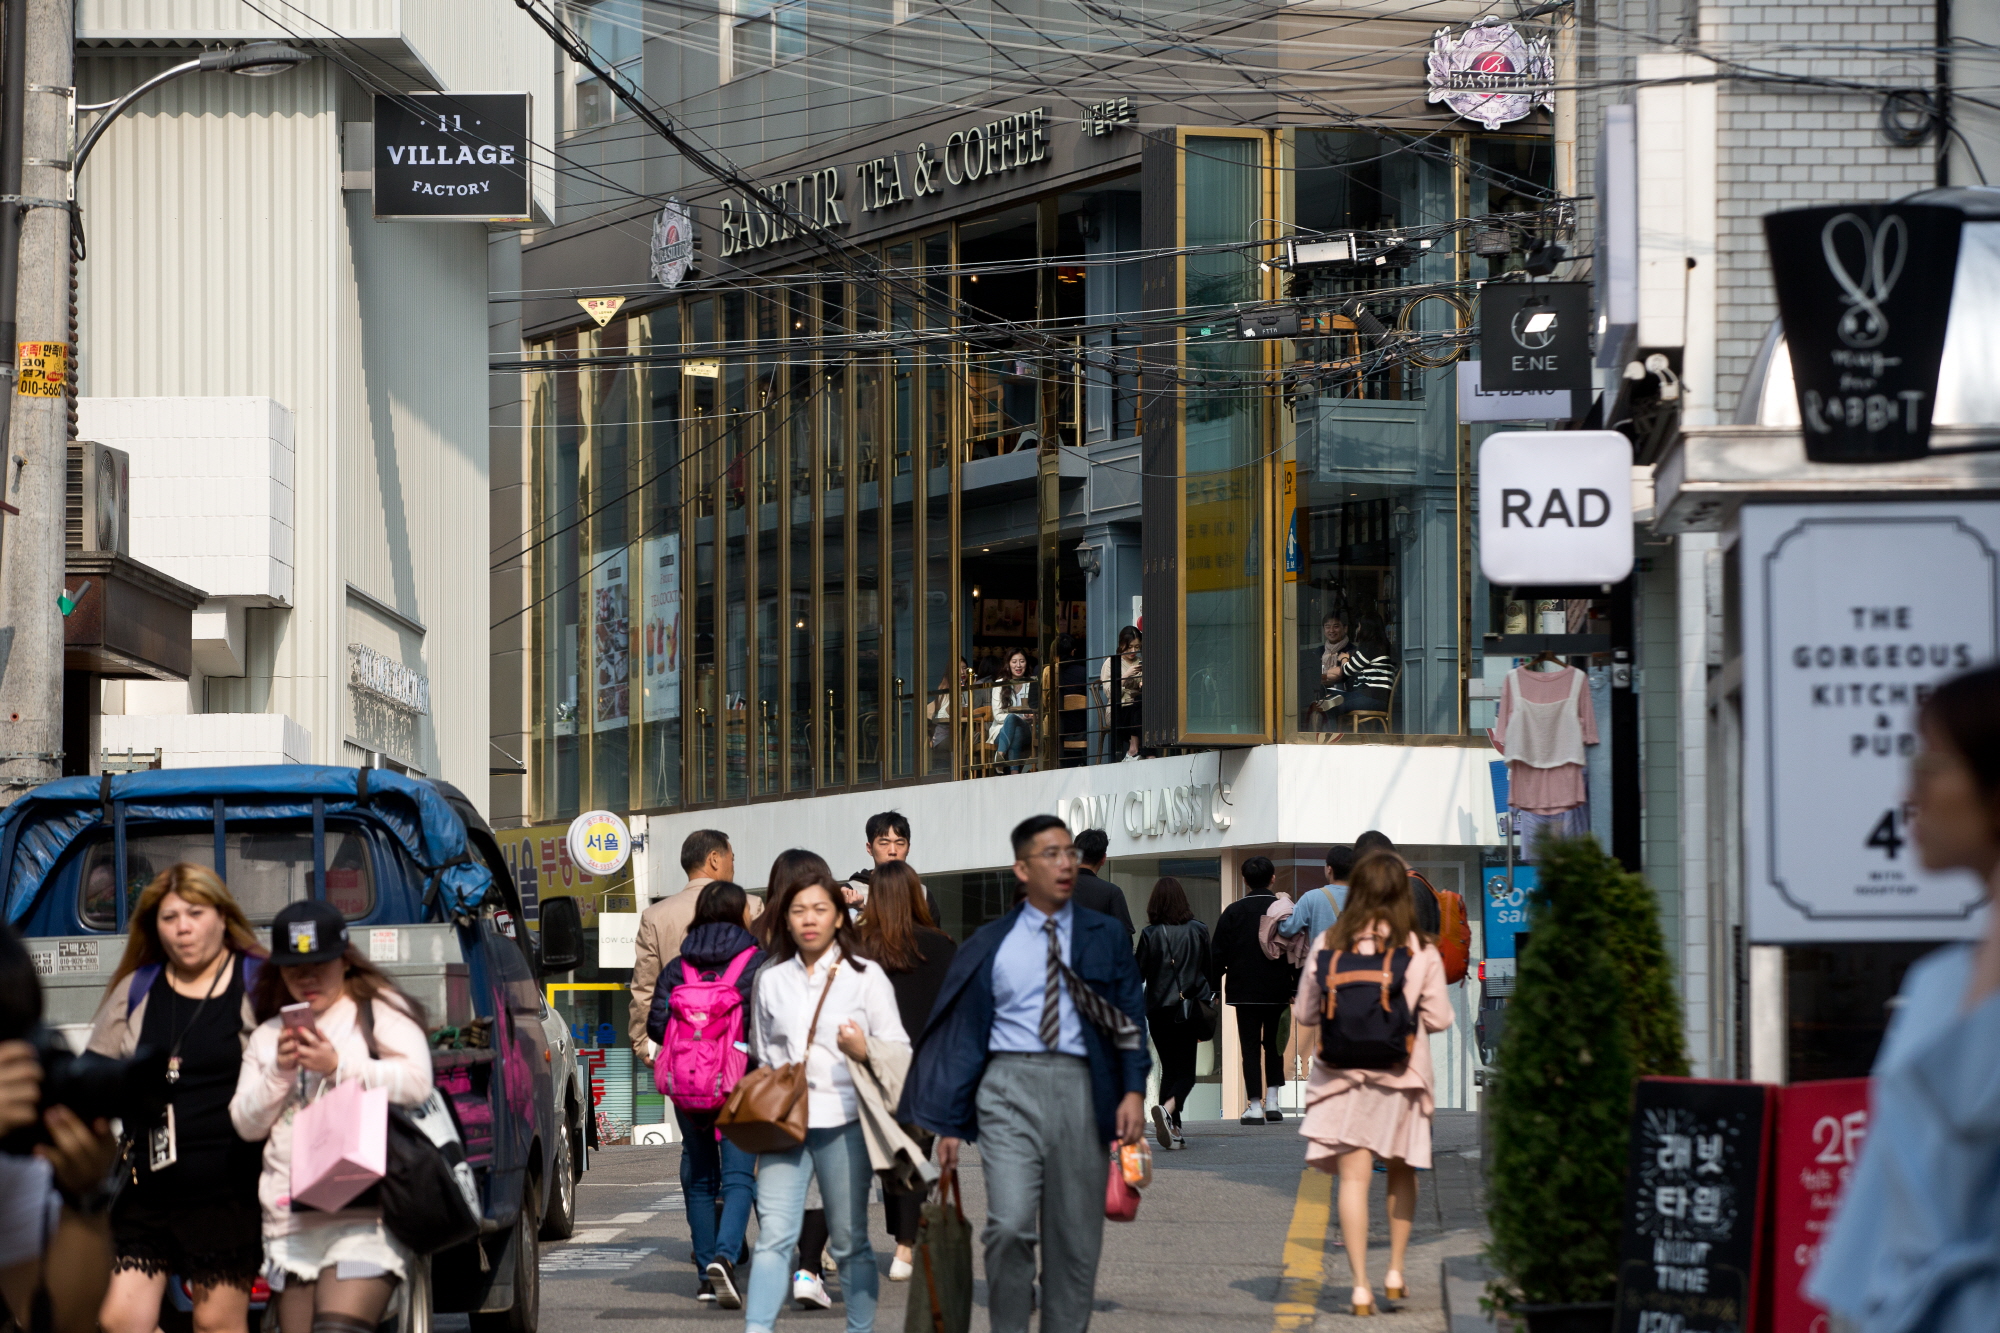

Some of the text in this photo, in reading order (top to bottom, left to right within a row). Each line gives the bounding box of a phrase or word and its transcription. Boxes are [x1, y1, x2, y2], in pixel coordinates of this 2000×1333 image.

[438, 115, 461, 132] 11
[386, 145, 515, 165] VILLAGE
[856, 149, 906, 213] TEA
[914, 141, 937, 198] &
[944, 106, 1047, 186] COFFEE
[411, 180, 490, 196] FACTORY
[1502, 488, 1611, 528] RAD
[1851, 605, 1911, 630] THE
[1791, 642, 1971, 669] GORGEOUS
[1810, 682, 1937, 706] KITCHE
[1123, 782, 1232, 838] CLASSIC
[586, 833, 619, 851] 서울
